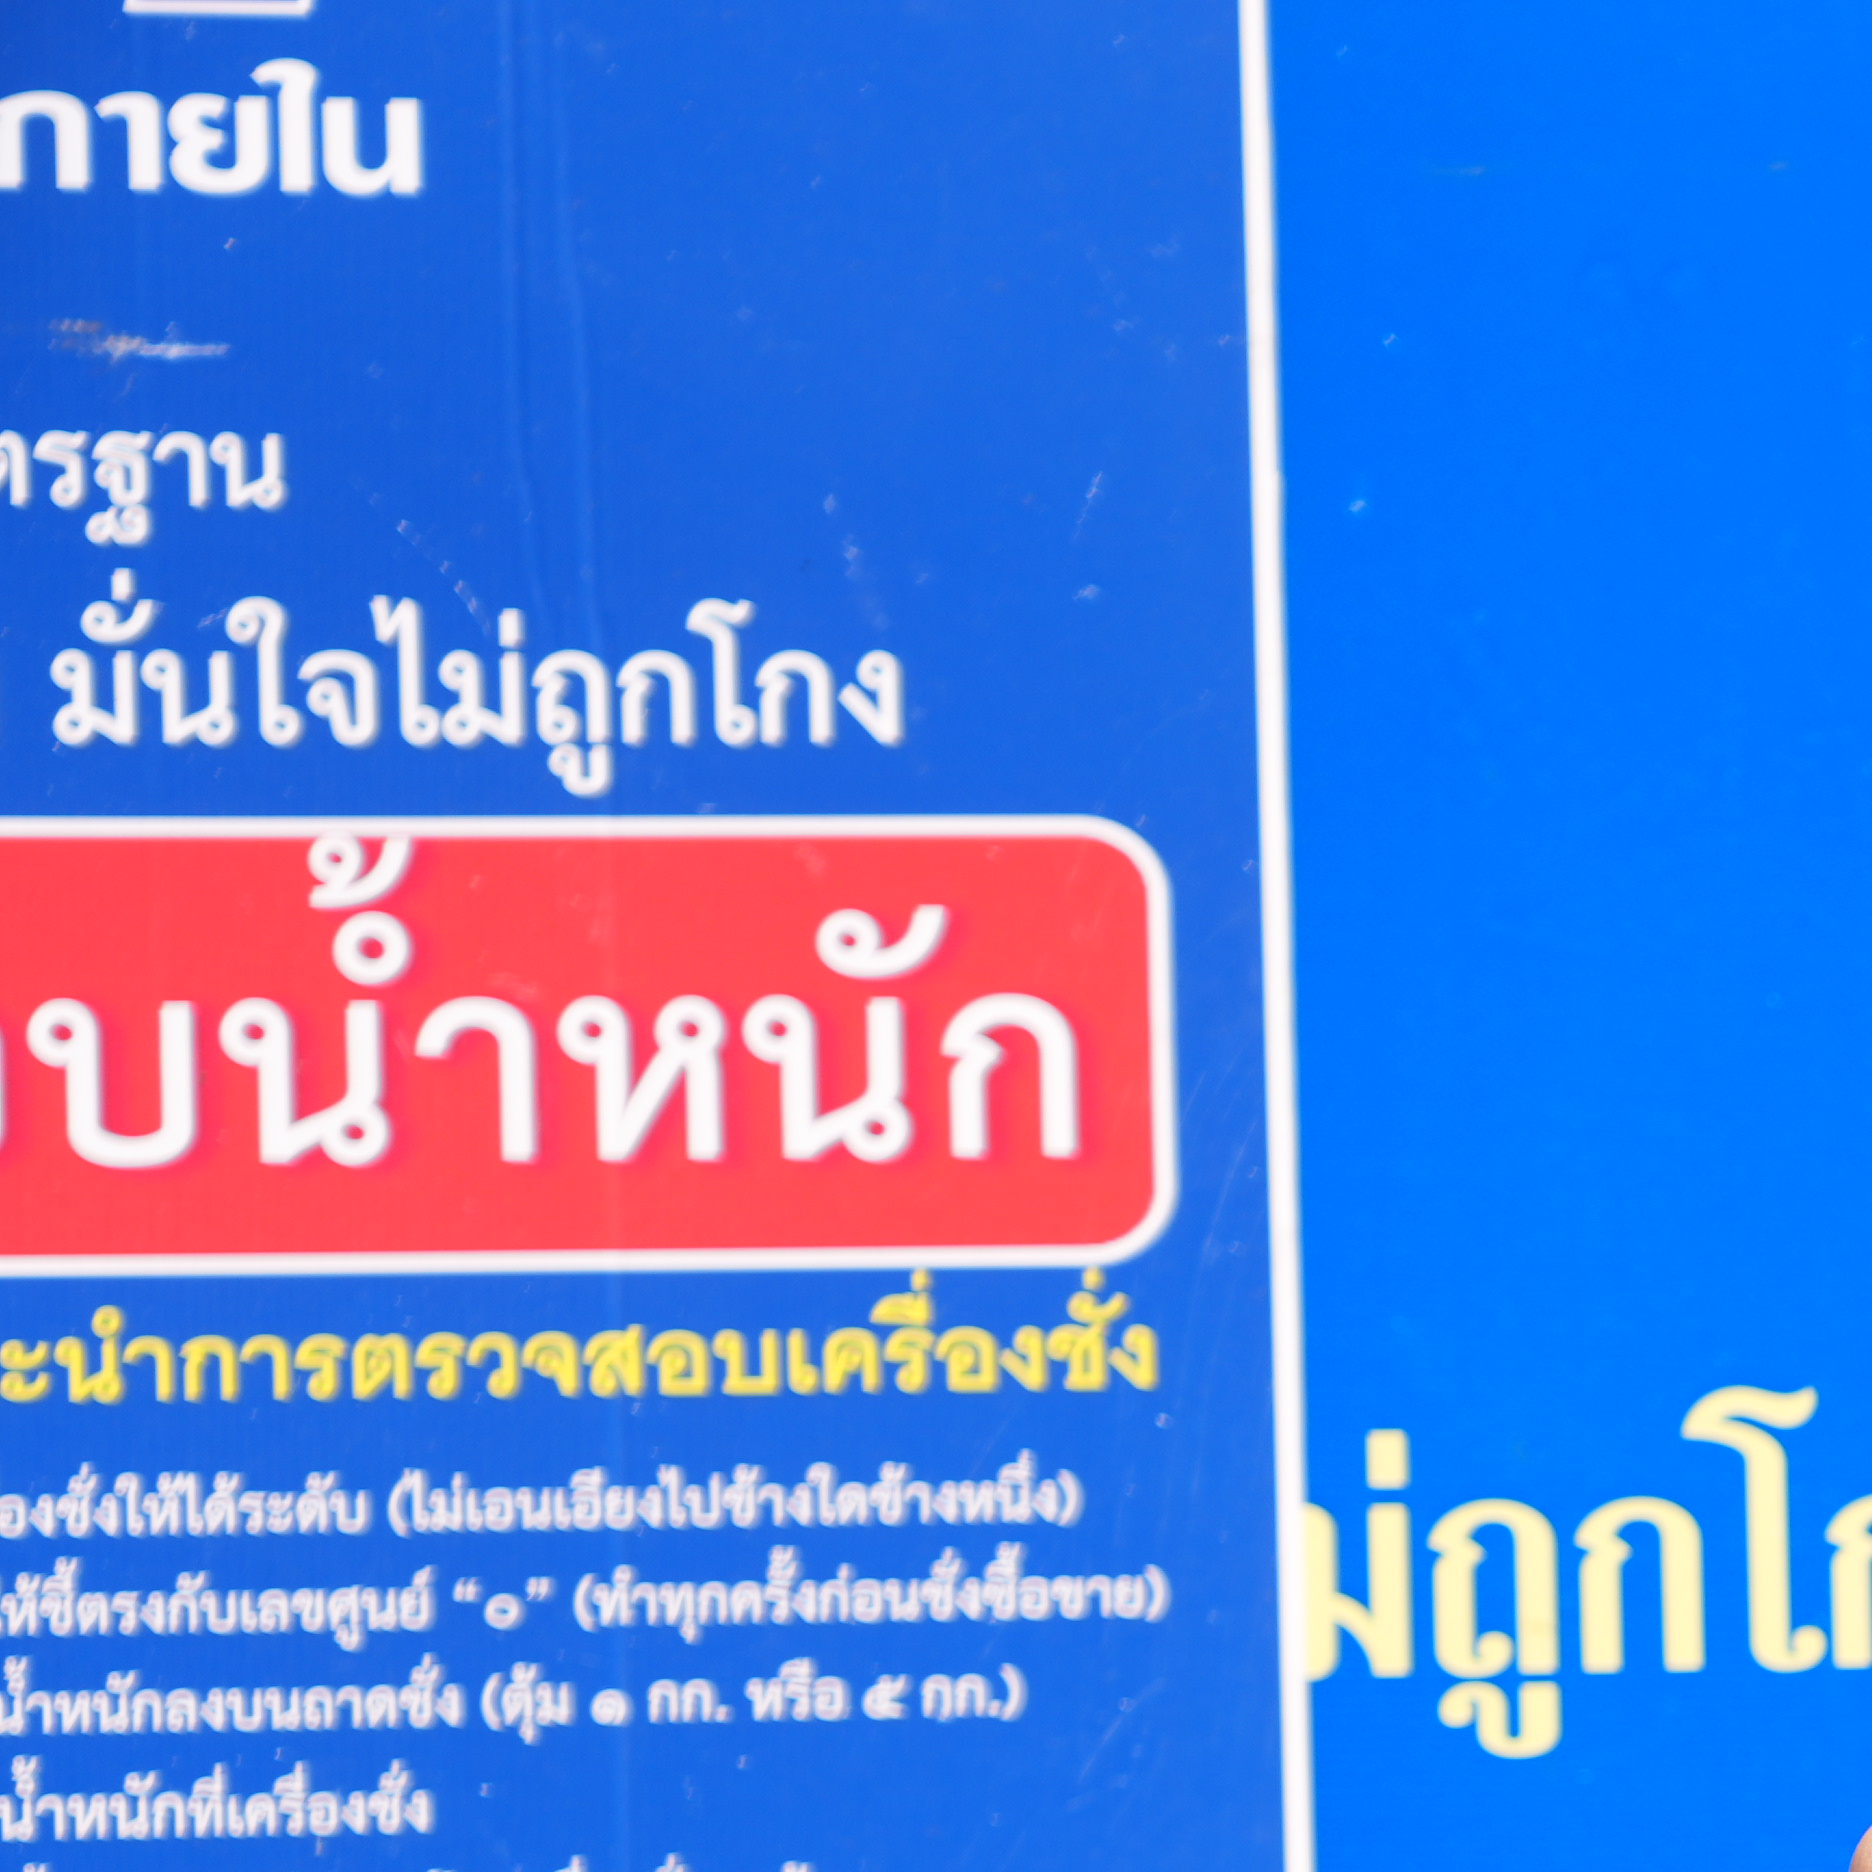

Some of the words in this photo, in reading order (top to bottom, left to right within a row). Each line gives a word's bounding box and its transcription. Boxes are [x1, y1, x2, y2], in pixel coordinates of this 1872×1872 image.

[50, 568, 903, 797] มั่นใจไม่ถูกโกง
[0, 830, 1078, 1168] บน้ำหนัก
[0, 1268, 1159, 1403] ะนำการตรวจสอบเครื่องชั่ง
[0, 1556, 436, 1652] ห้ชี้ตรงกับเลขศูนย์
[647, 1677, 730, 1723] กก.
[745, 1656, 850, 1721] หรือ
